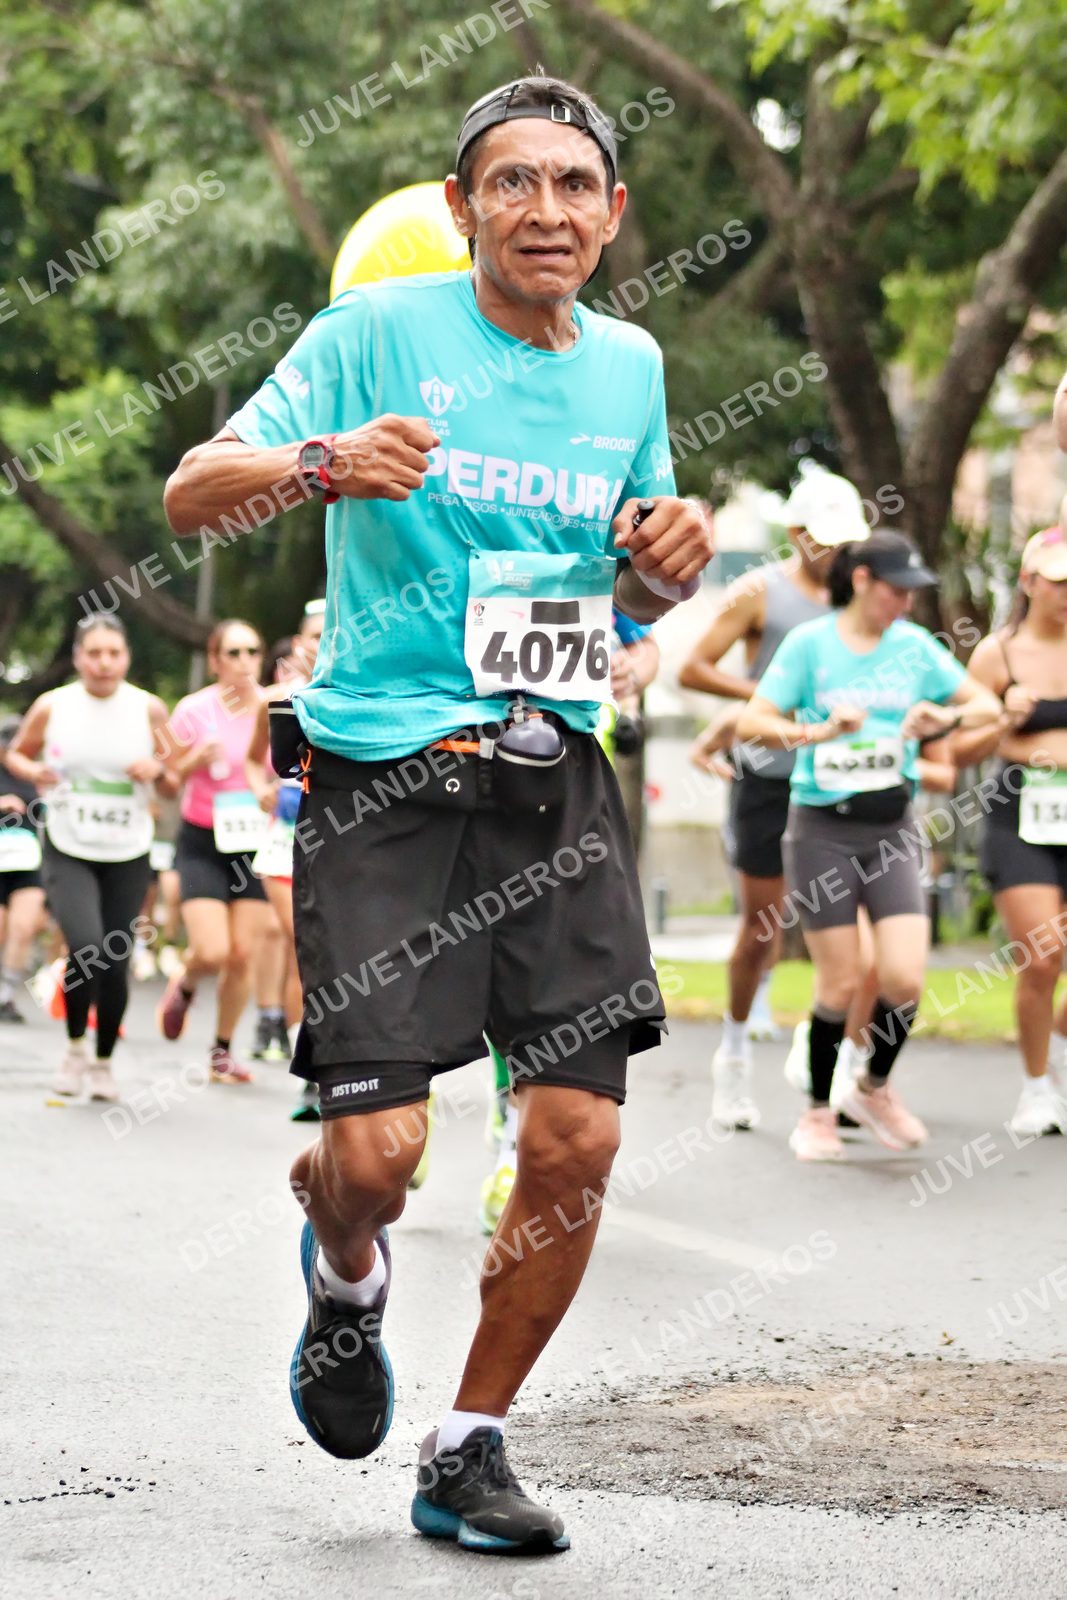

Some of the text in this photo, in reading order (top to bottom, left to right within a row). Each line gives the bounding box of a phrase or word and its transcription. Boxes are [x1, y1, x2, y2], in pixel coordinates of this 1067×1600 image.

[593, 435, 636, 453] BROOKS
[428, 492, 460, 507] PEGA
[506, 506, 580, 529] JUNTEADORES
[480, 629, 609, 683] 4076
[332, 1078, 379, 1098] JUST DO IT
